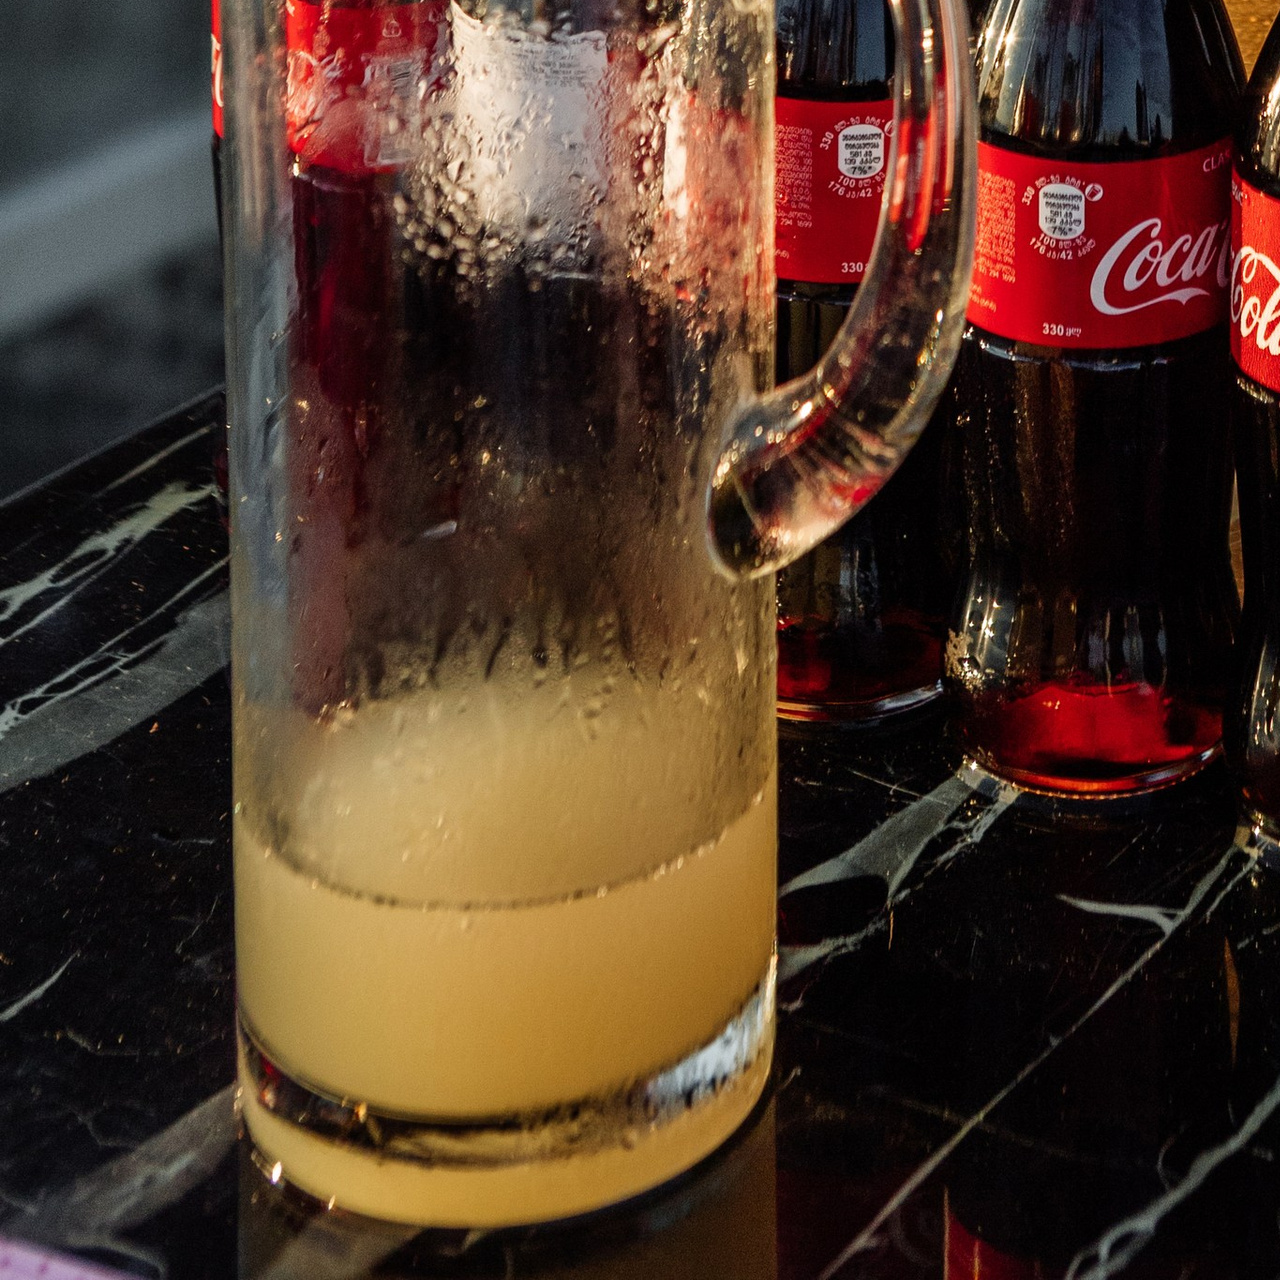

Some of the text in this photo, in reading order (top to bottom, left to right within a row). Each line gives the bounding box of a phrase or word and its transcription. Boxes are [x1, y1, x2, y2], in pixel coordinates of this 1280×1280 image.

[828, 181, 846, 196] 176
[838, 175, 856, 188] 100
[1038, 233, 1057, 248] 100
[841, 262, 863, 273] 330
[1042, 322, 1065, 337] 330
